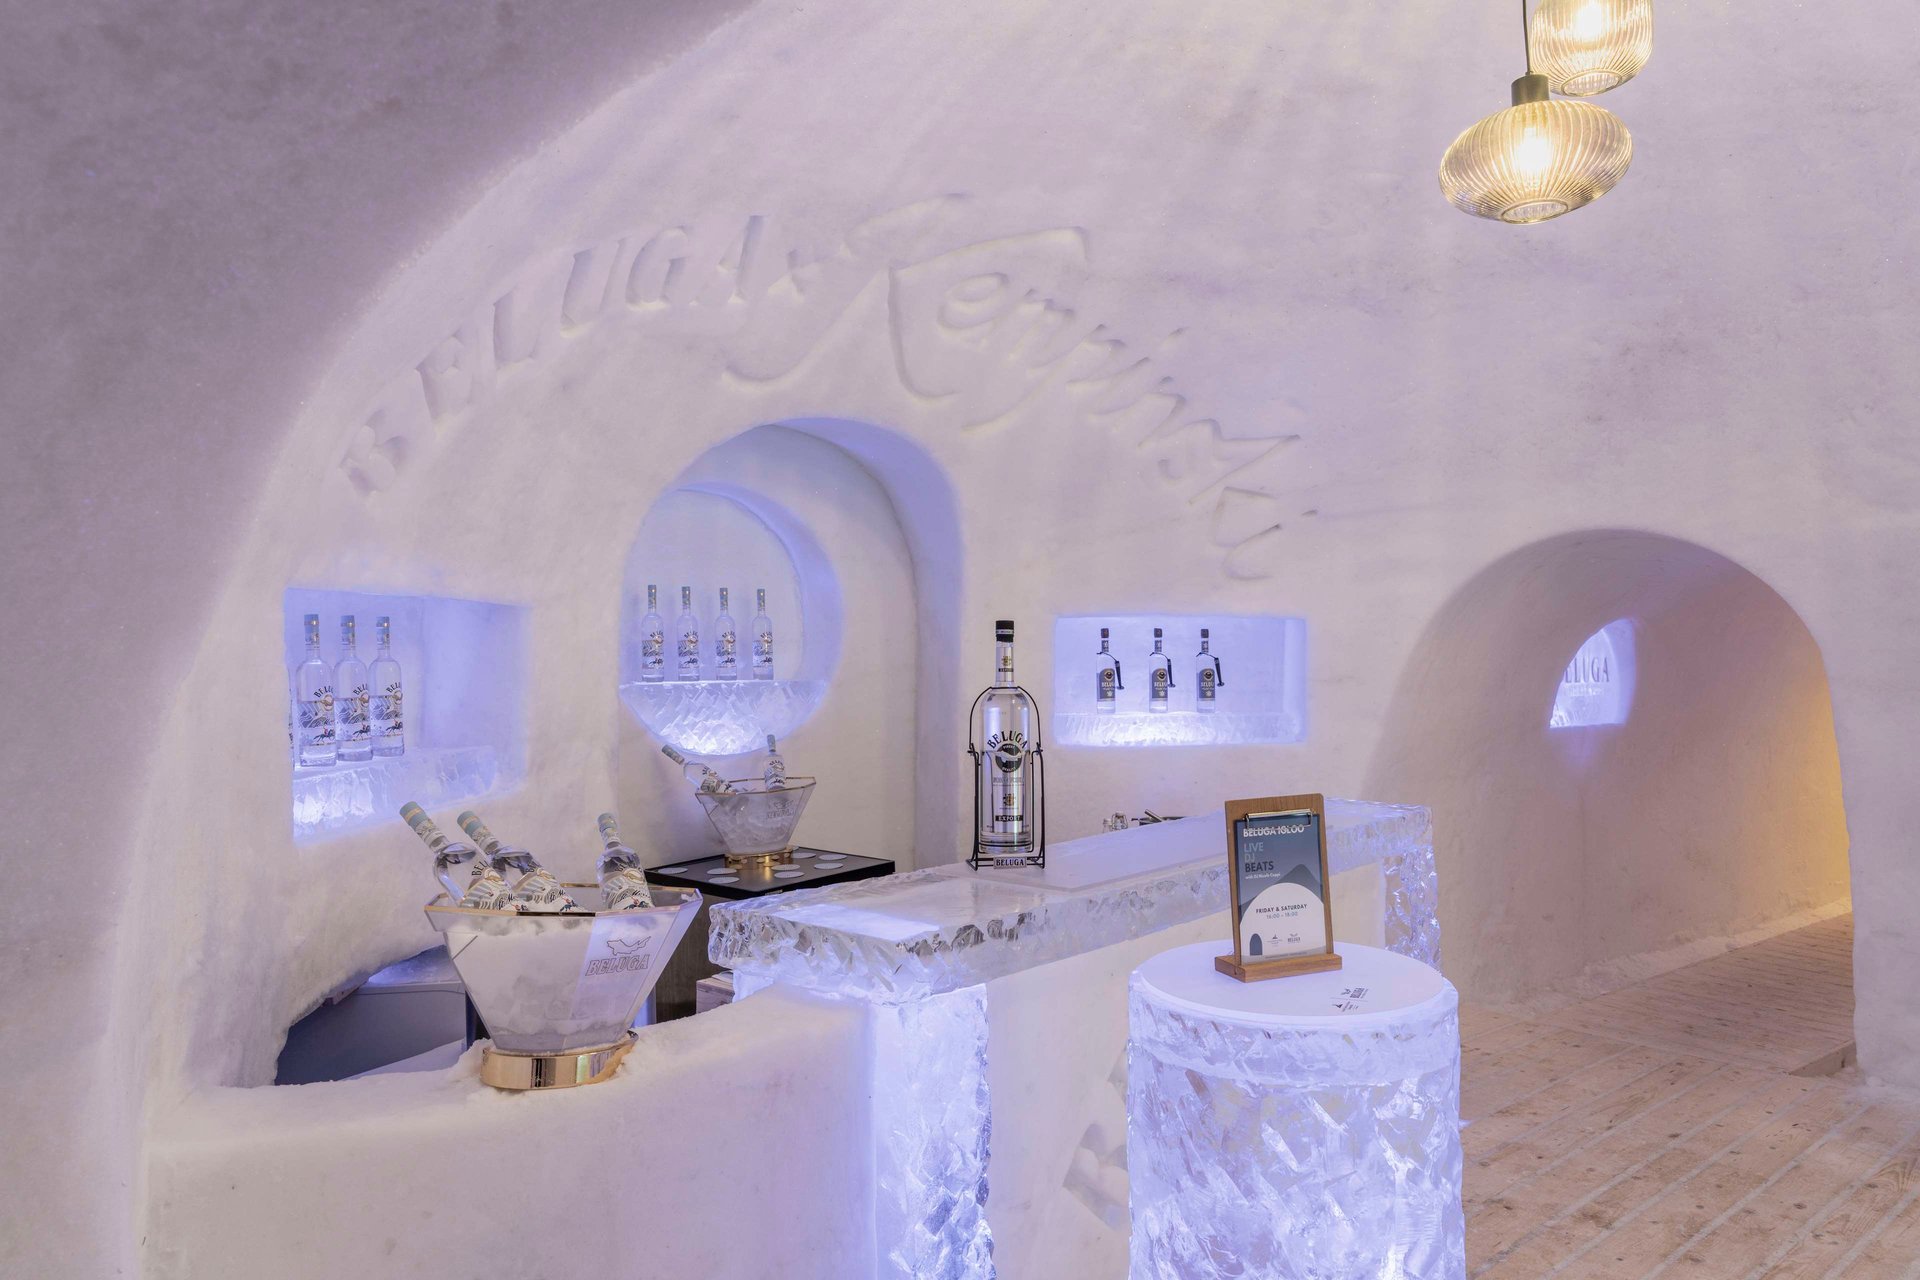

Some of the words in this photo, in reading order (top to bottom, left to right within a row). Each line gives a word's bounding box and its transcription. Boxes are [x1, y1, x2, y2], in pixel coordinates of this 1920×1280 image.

[338, 213, 770, 498] BELUGA
[987, 730, 1028, 749] BELUGA
[1243, 826, 1277, 838] BELUGA
[1277, 824, 1305, 835] IGLOO
[1244, 842, 1264, 853] LIVE
[996, 858, 1025, 867] BELUGA
[1244, 853, 1256, 863] DJ
[1245, 861, 1274, 873] BEATS
[1255, 906, 1274, 914] FRIDAY
[585, 954, 651, 977] BELUGA
